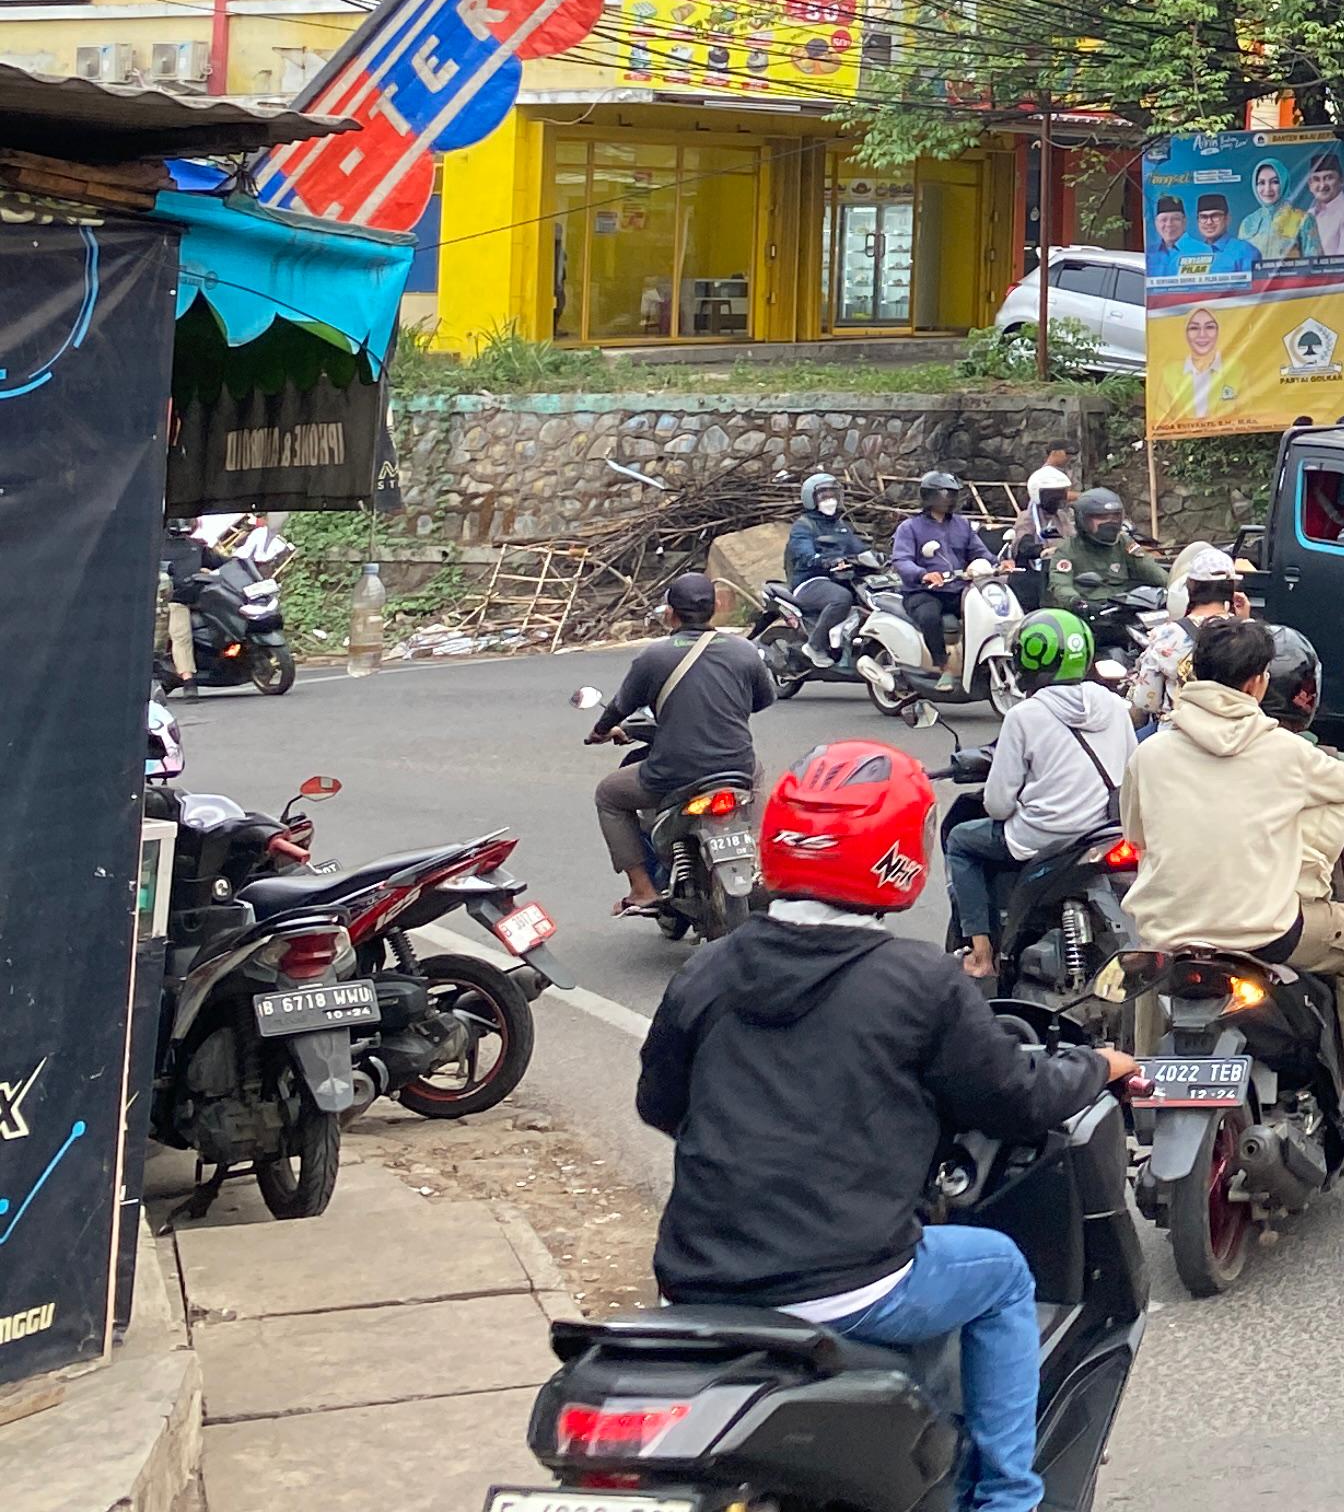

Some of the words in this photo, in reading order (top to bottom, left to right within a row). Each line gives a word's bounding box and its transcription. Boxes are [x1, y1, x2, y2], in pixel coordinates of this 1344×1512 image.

[1310, 374, 1343, 384] GOLKAR
[262, 1000, 274, 1016] B
[281, 993, 327, 1013] 6718
[333, 986, 370, 1006] WWU
[1154, 1064, 1200, 1082] 4022
[1210, 1063, 1243, 1082] TEB
